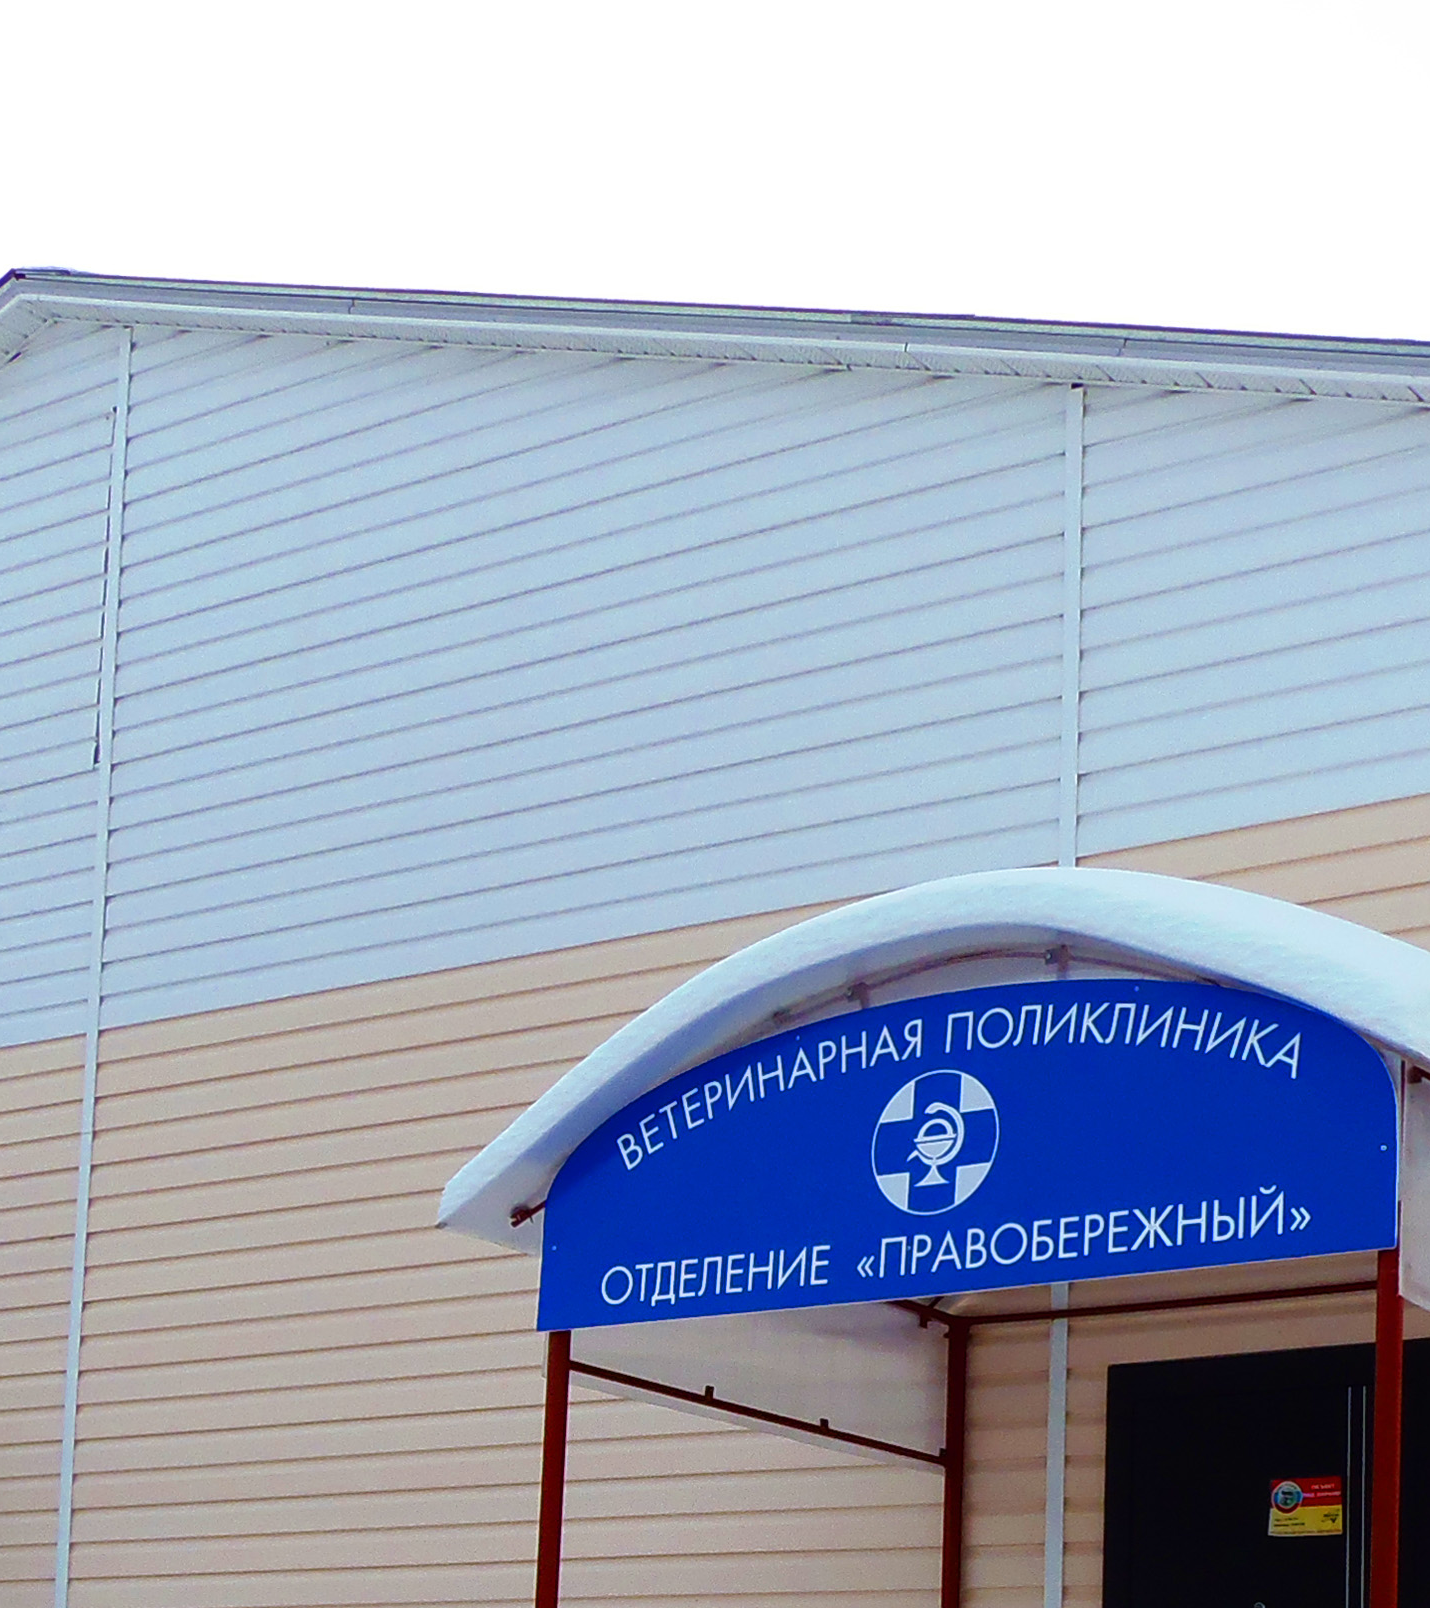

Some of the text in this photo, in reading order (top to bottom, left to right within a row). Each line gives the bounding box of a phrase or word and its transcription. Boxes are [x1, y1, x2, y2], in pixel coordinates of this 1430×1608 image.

[618, 1003, 1301, 1170] ВЕТЕРИНАРНАЯ ПОЛИКЛИНИКА
[601, 1184, 1311, 1307] ОТДЕЛЕНИЕ «ПРАВОБЕРЕЖНЫЙ»
